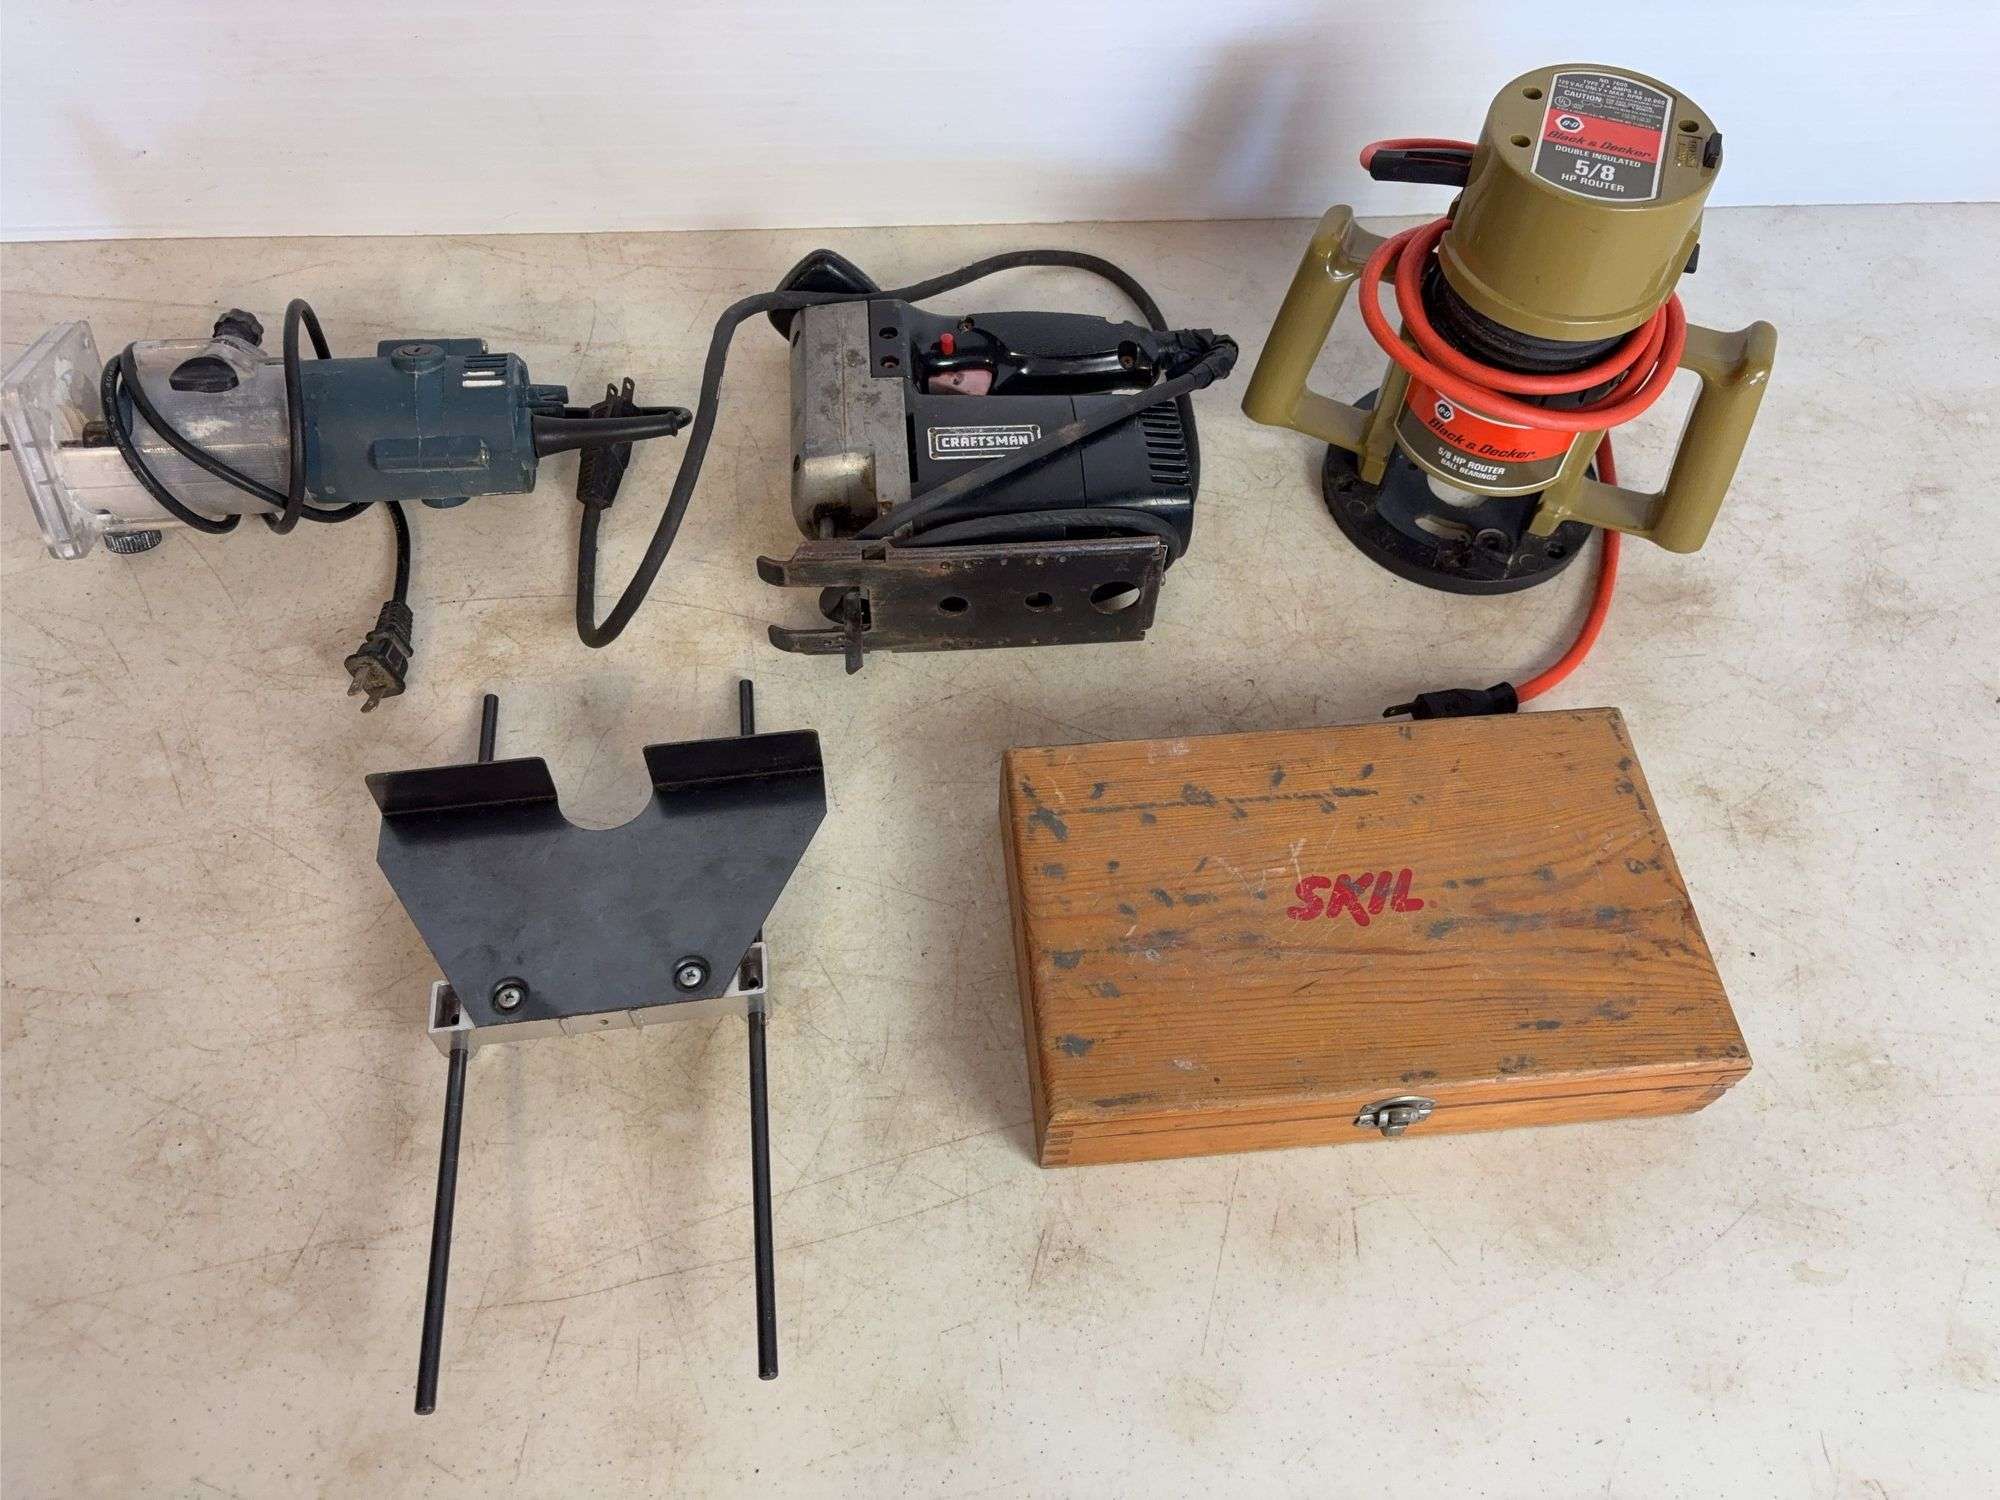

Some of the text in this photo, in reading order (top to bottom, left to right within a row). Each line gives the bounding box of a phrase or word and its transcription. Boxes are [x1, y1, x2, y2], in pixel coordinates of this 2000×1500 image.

[1564, 89, 1602, 103] CAUTION
[1547, 130, 1586, 145] Black
[1600, 141, 1652, 158] Decker
[1555, 145, 1641, 168] DOUBLE INSULATED
[1574, 159, 1616, 181] 5/8
[1561, 173, 1625, 192] HP ROUTER
[941, 434, 1030, 448] CRAFTSMAN
[1428, 418, 1465, 447] Black
[1478, 444, 1536, 459] Decker
[1438, 447, 1506, 475] 5/8 HP ROUTER
[1440, 459, 1498, 481] BALL BEARINGS
[1287, 868, 1424, 927] SKIL
